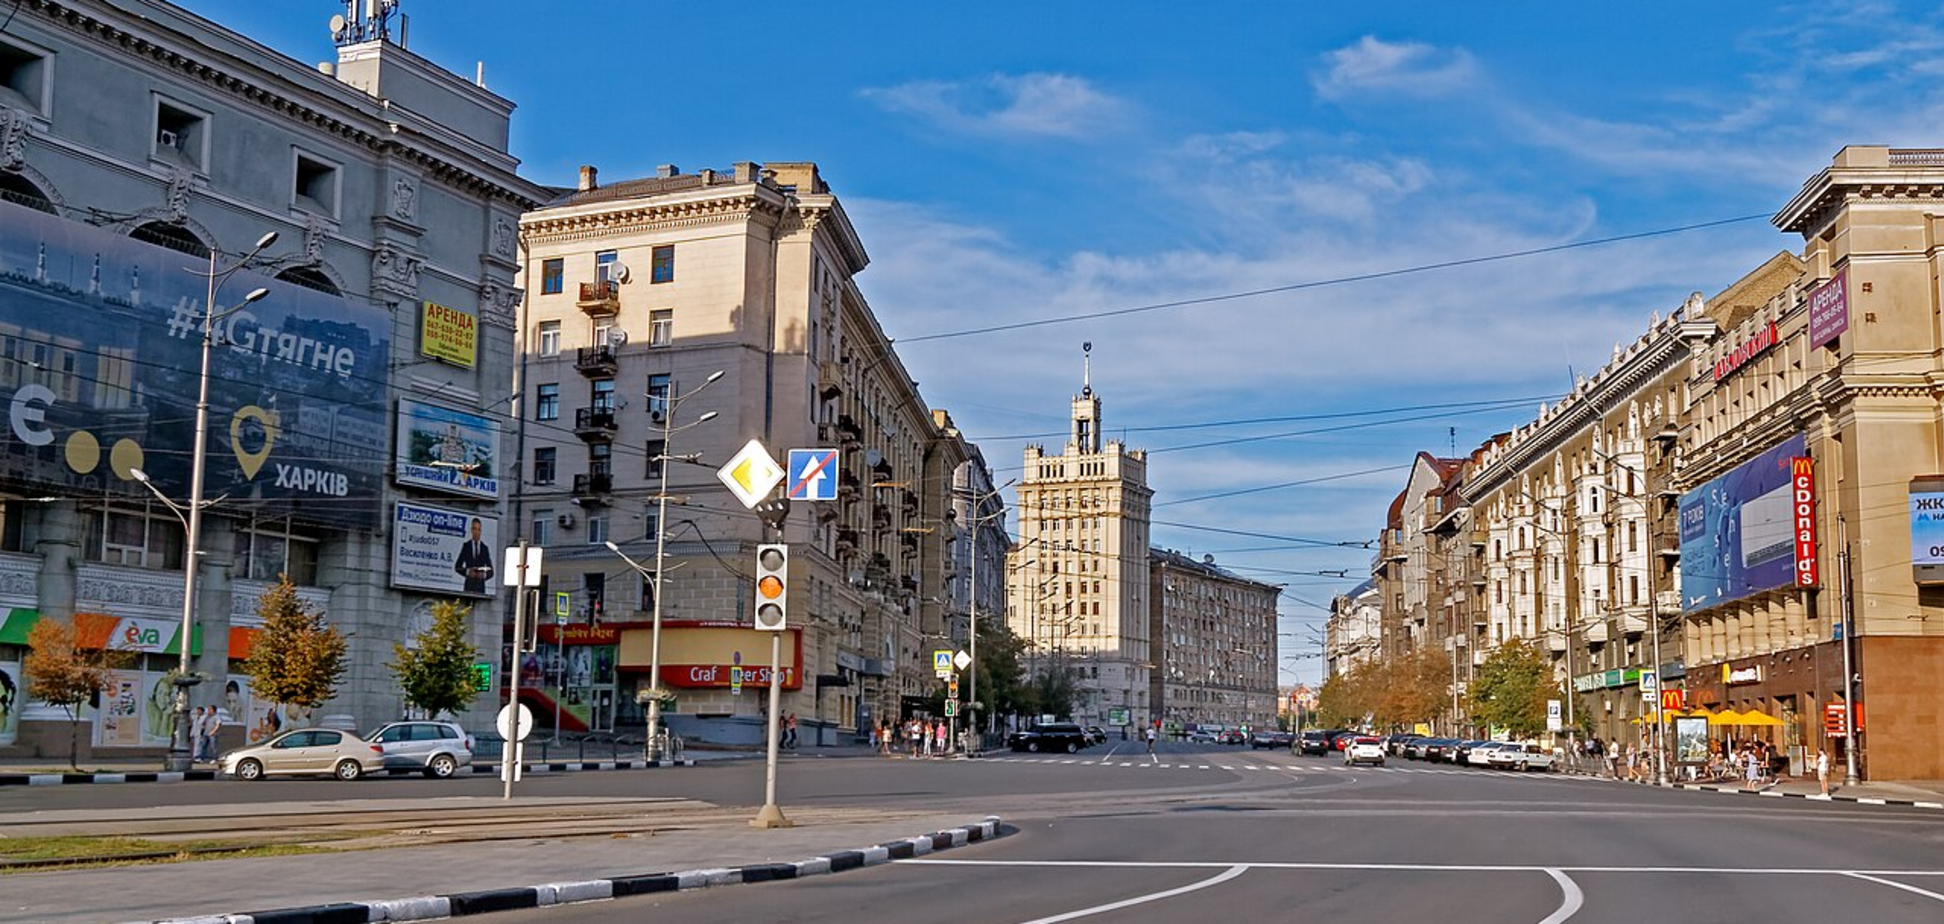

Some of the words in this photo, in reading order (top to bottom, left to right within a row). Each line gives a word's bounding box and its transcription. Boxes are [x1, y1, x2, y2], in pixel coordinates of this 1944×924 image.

[1812, 280, 1843, 314] АРЕНДА
[428, 304, 473, 330] АРЕНДА
[274, 462, 349, 497] ХАРКІВ
[401, 507, 432, 524] Дзюдо
[433, 514, 463, 528] on-line
[759, 668, 785, 684] Shp
